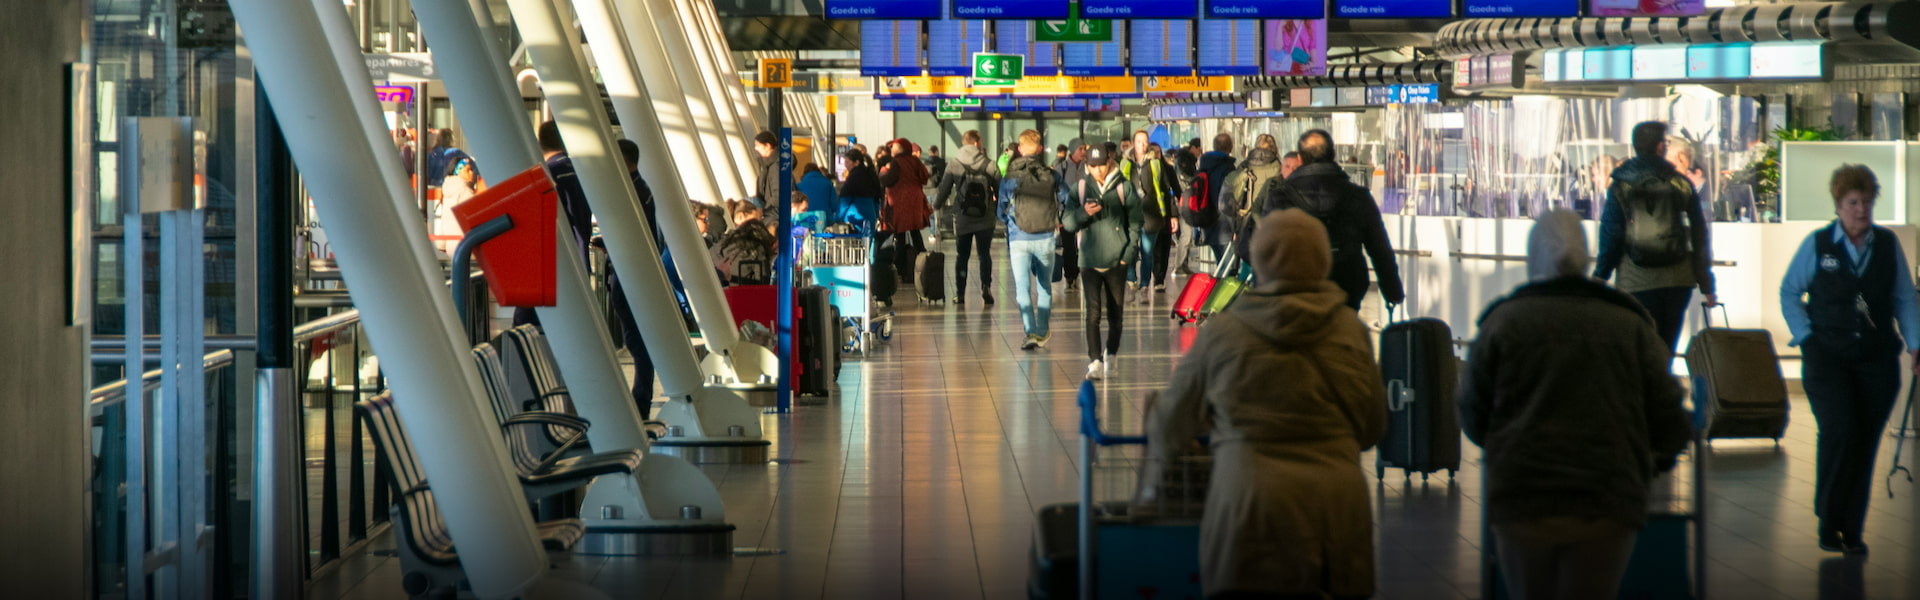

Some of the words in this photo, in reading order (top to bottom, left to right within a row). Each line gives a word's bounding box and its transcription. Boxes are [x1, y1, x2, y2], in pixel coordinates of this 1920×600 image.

[831, 6, 858, 15] Goede
[860, 6, 876, 15] reis
[958, 6, 985, 14] Goede
[987, 6, 1003, 14] reis
[1087, 5, 1114, 14] Goede
[1115, 5, 1131, 14] reis
[1213, 5, 1240, 14] Goede
[1242, 5, 1258, 14] reis
[1341, 5, 1368, 14] Goede
[1369, 5, 1385, 14] reis
[1469, 5, 1496, 13] Goede
[1497, 5, 1513, 13] reis
[365, 58, 420, 69] epartures
[931, 78, 951, 86] Trains
[1173, 76, 1195, 85] Gates
[1197, 75, 1209, 87] M
